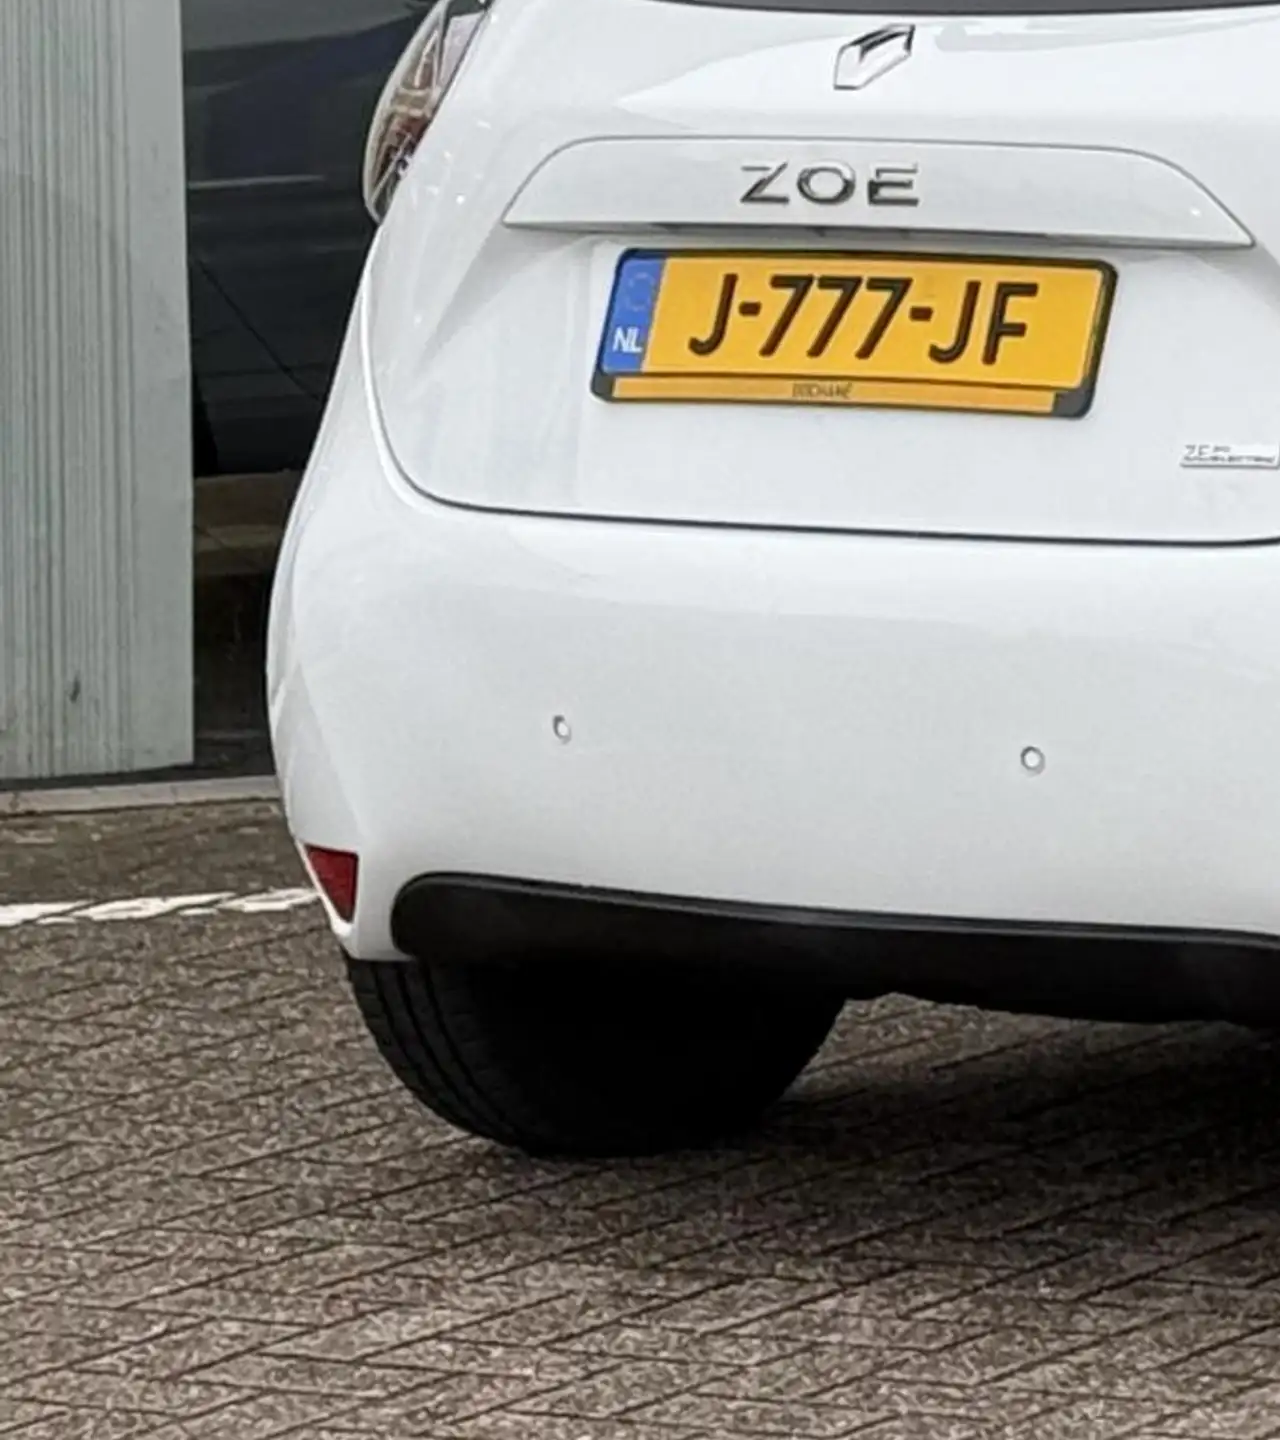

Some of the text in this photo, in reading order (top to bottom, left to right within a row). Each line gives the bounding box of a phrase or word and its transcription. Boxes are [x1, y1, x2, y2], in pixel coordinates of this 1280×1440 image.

[739, 160, 920, 207] ZOE
[612, 272, 1039, 365] NL J-777-JF
